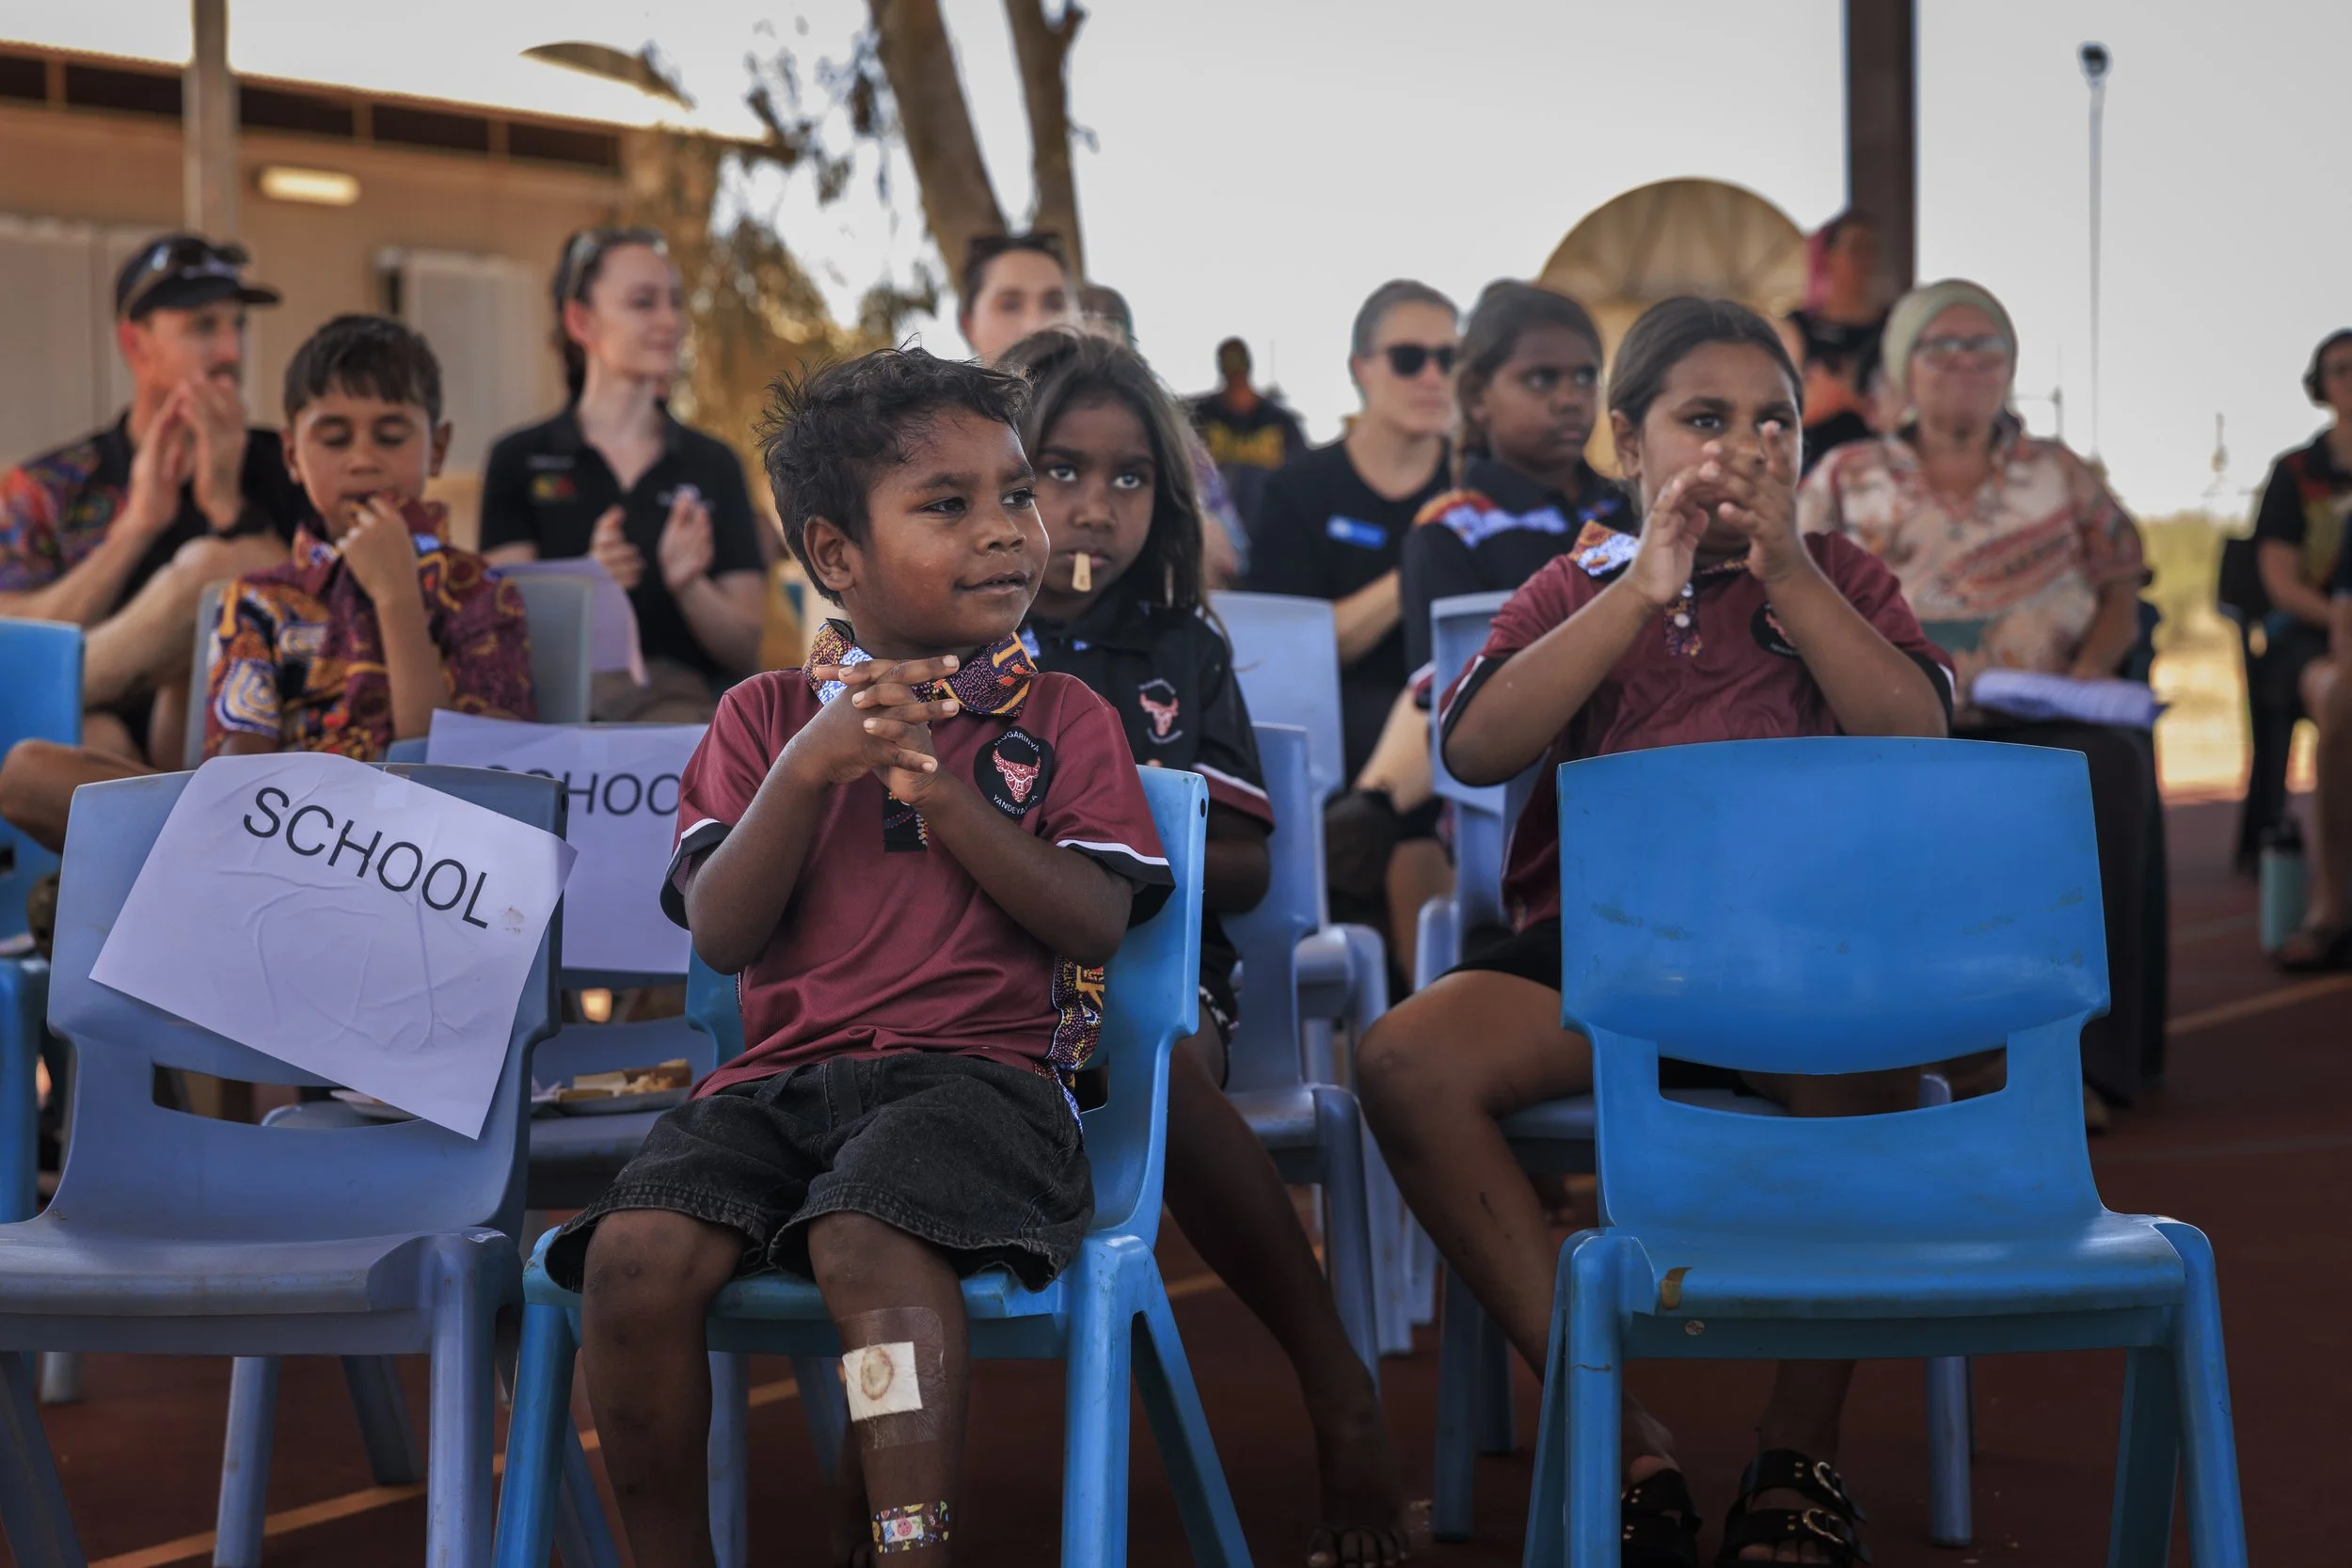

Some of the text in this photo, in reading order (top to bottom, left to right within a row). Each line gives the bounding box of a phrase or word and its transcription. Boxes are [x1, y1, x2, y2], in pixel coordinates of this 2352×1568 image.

[485, 764, 681, 816] HOO
[993, 794, 1039, 816] YANDEYAA
[243, 786, 488, 929] SCHOOL
